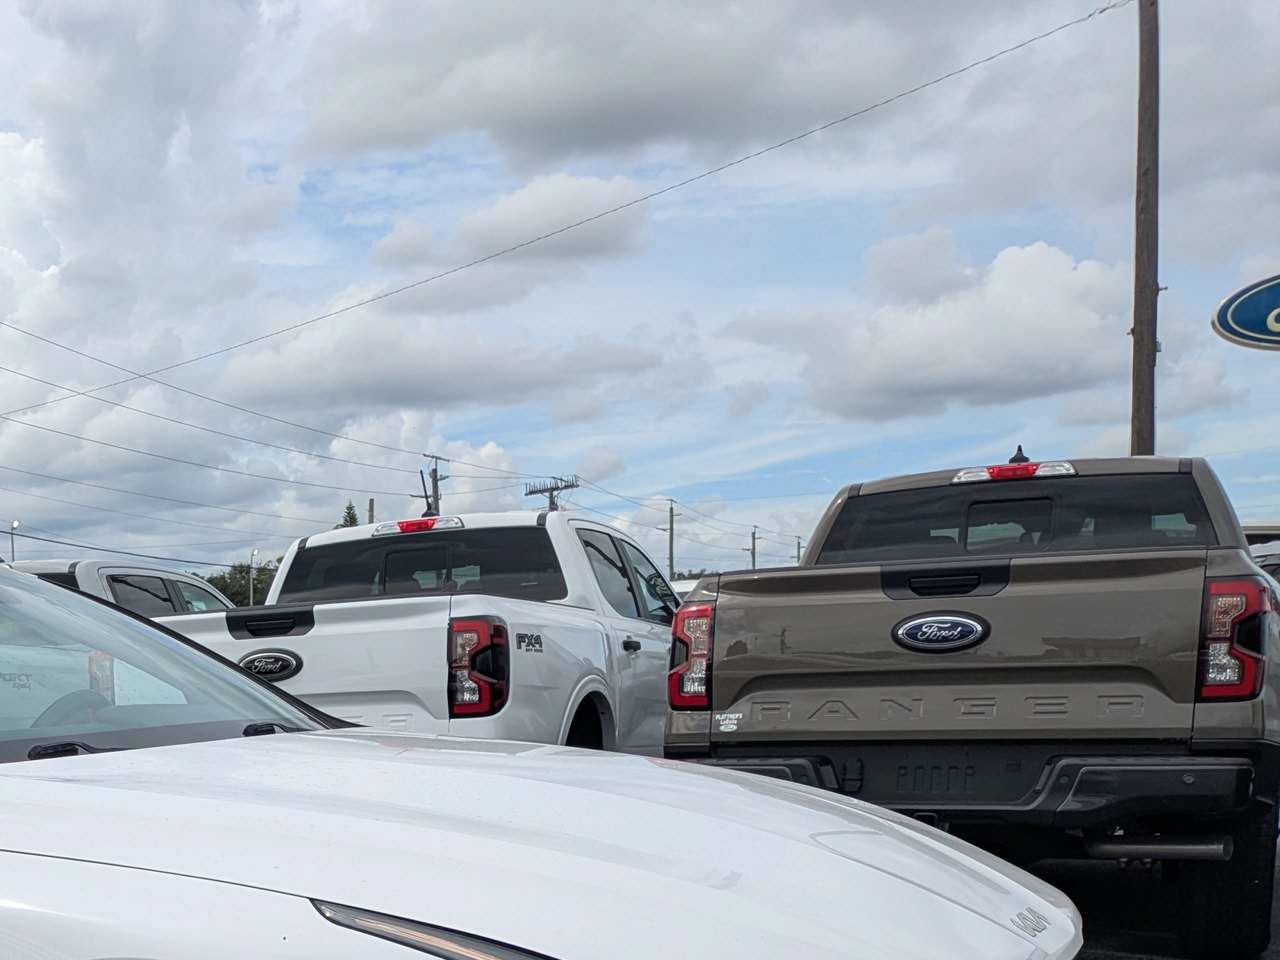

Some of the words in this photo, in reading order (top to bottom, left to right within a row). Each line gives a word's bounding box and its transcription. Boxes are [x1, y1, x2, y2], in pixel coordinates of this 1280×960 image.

[917, 623, 962, 640] Ford
[515, 632, 543, 649] FX4
[251, 658, 283, 673] Ford
[750, 694, 1145, 722] RANGER
